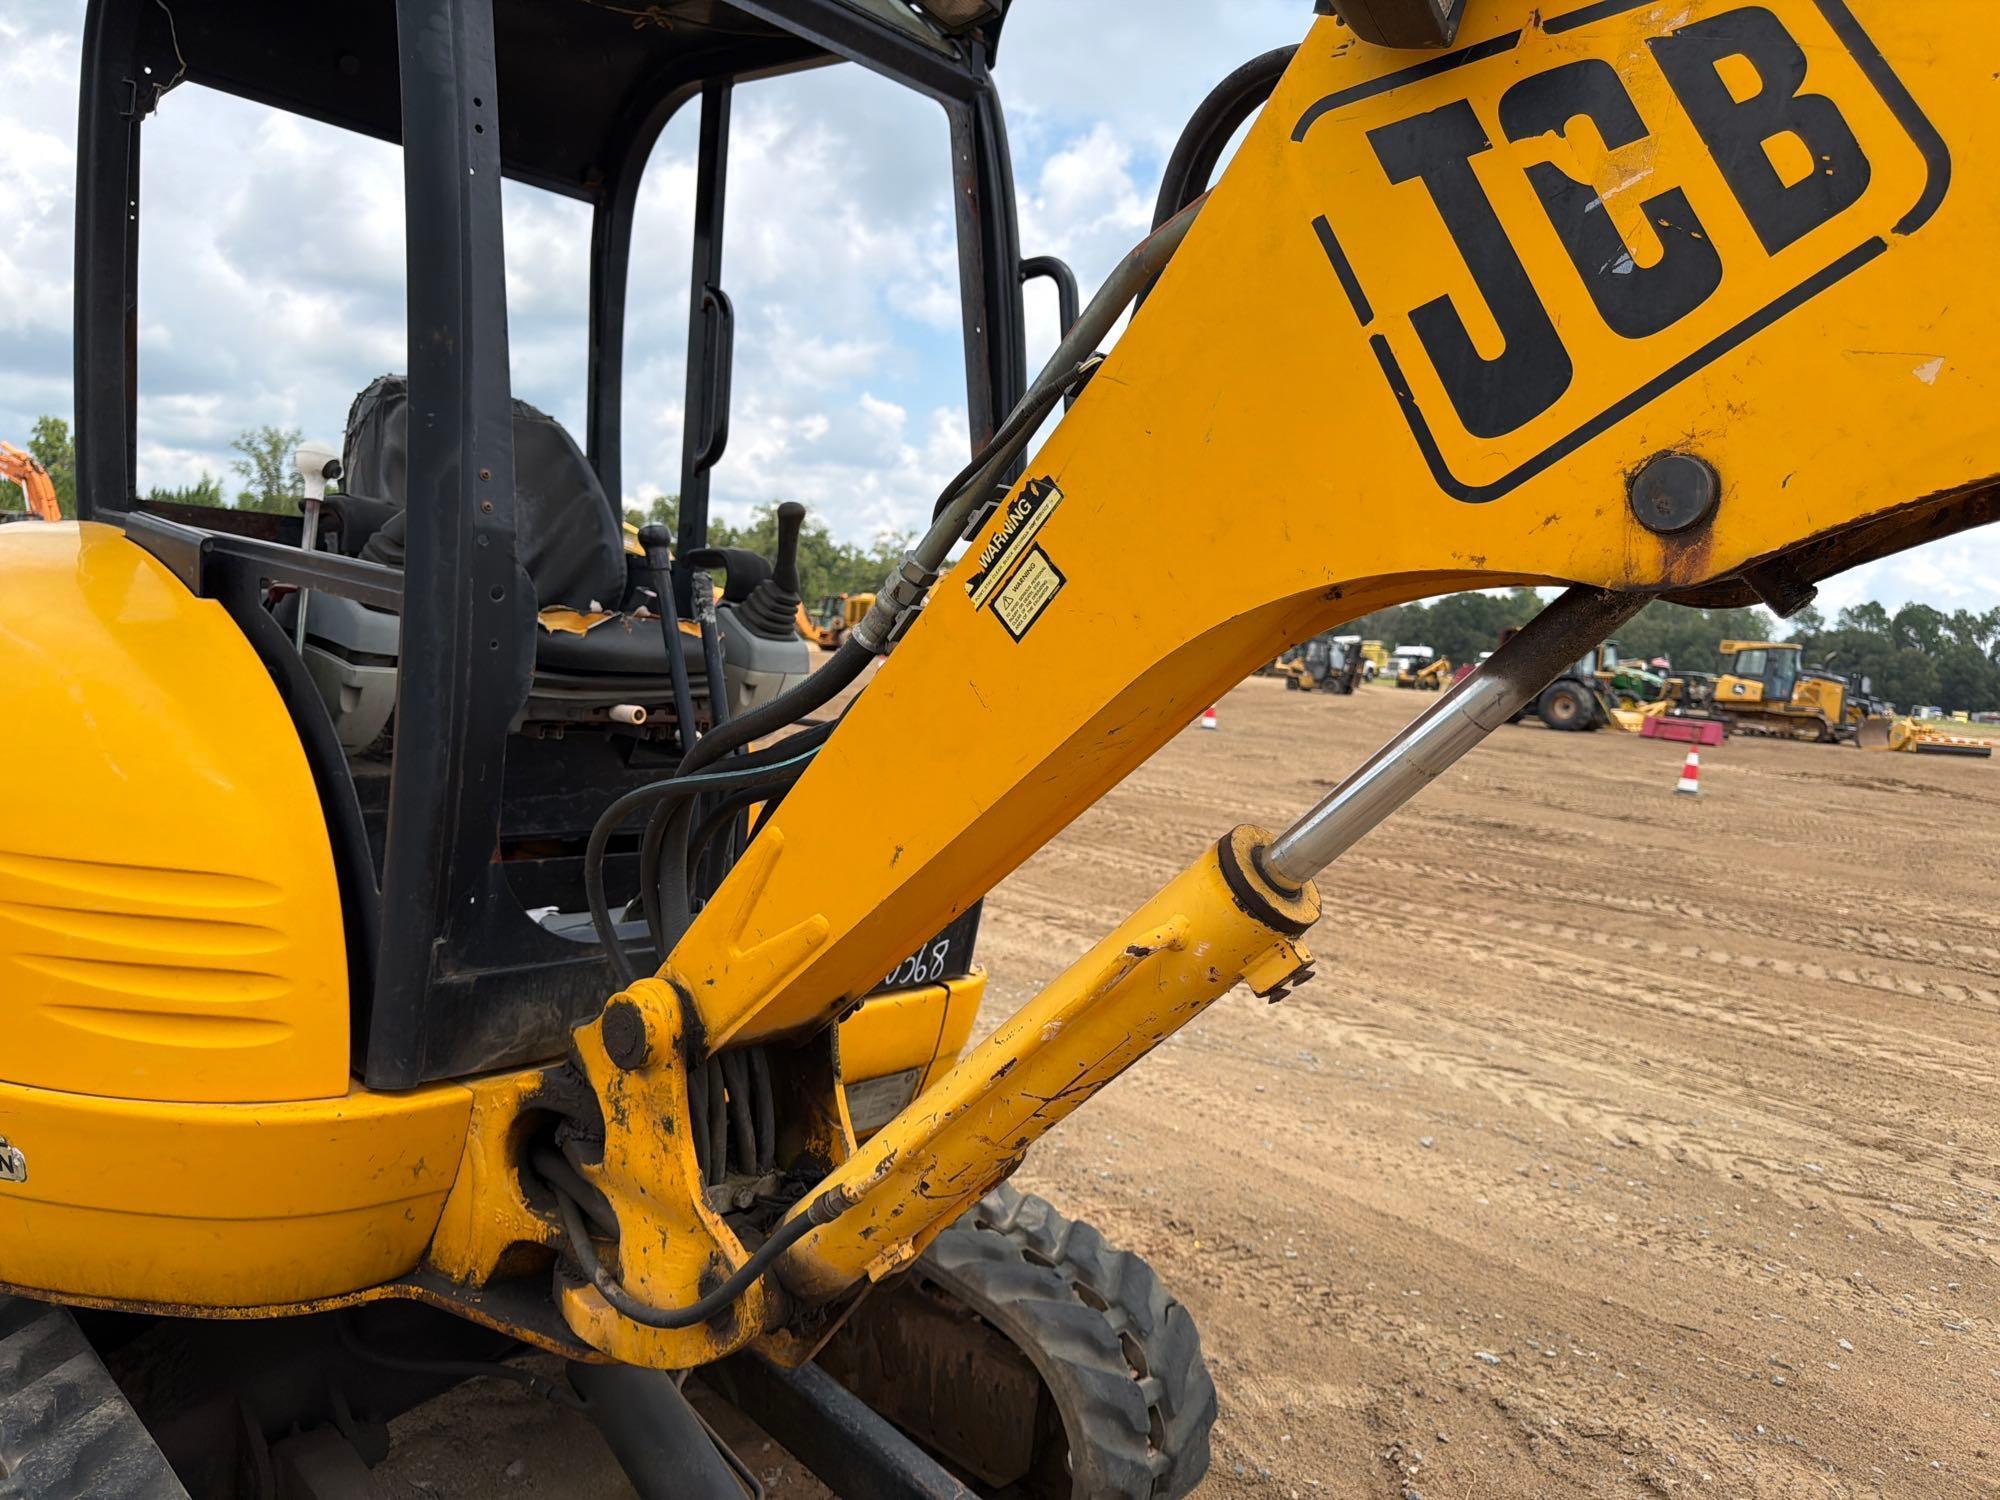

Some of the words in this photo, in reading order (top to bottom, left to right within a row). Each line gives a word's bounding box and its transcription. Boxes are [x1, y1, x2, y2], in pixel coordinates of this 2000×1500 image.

[1366, 6, 1871, 438] JCB
[979, 499, 1031, 569] WARNING
[1011, 561, 1036, 593] WARNING
